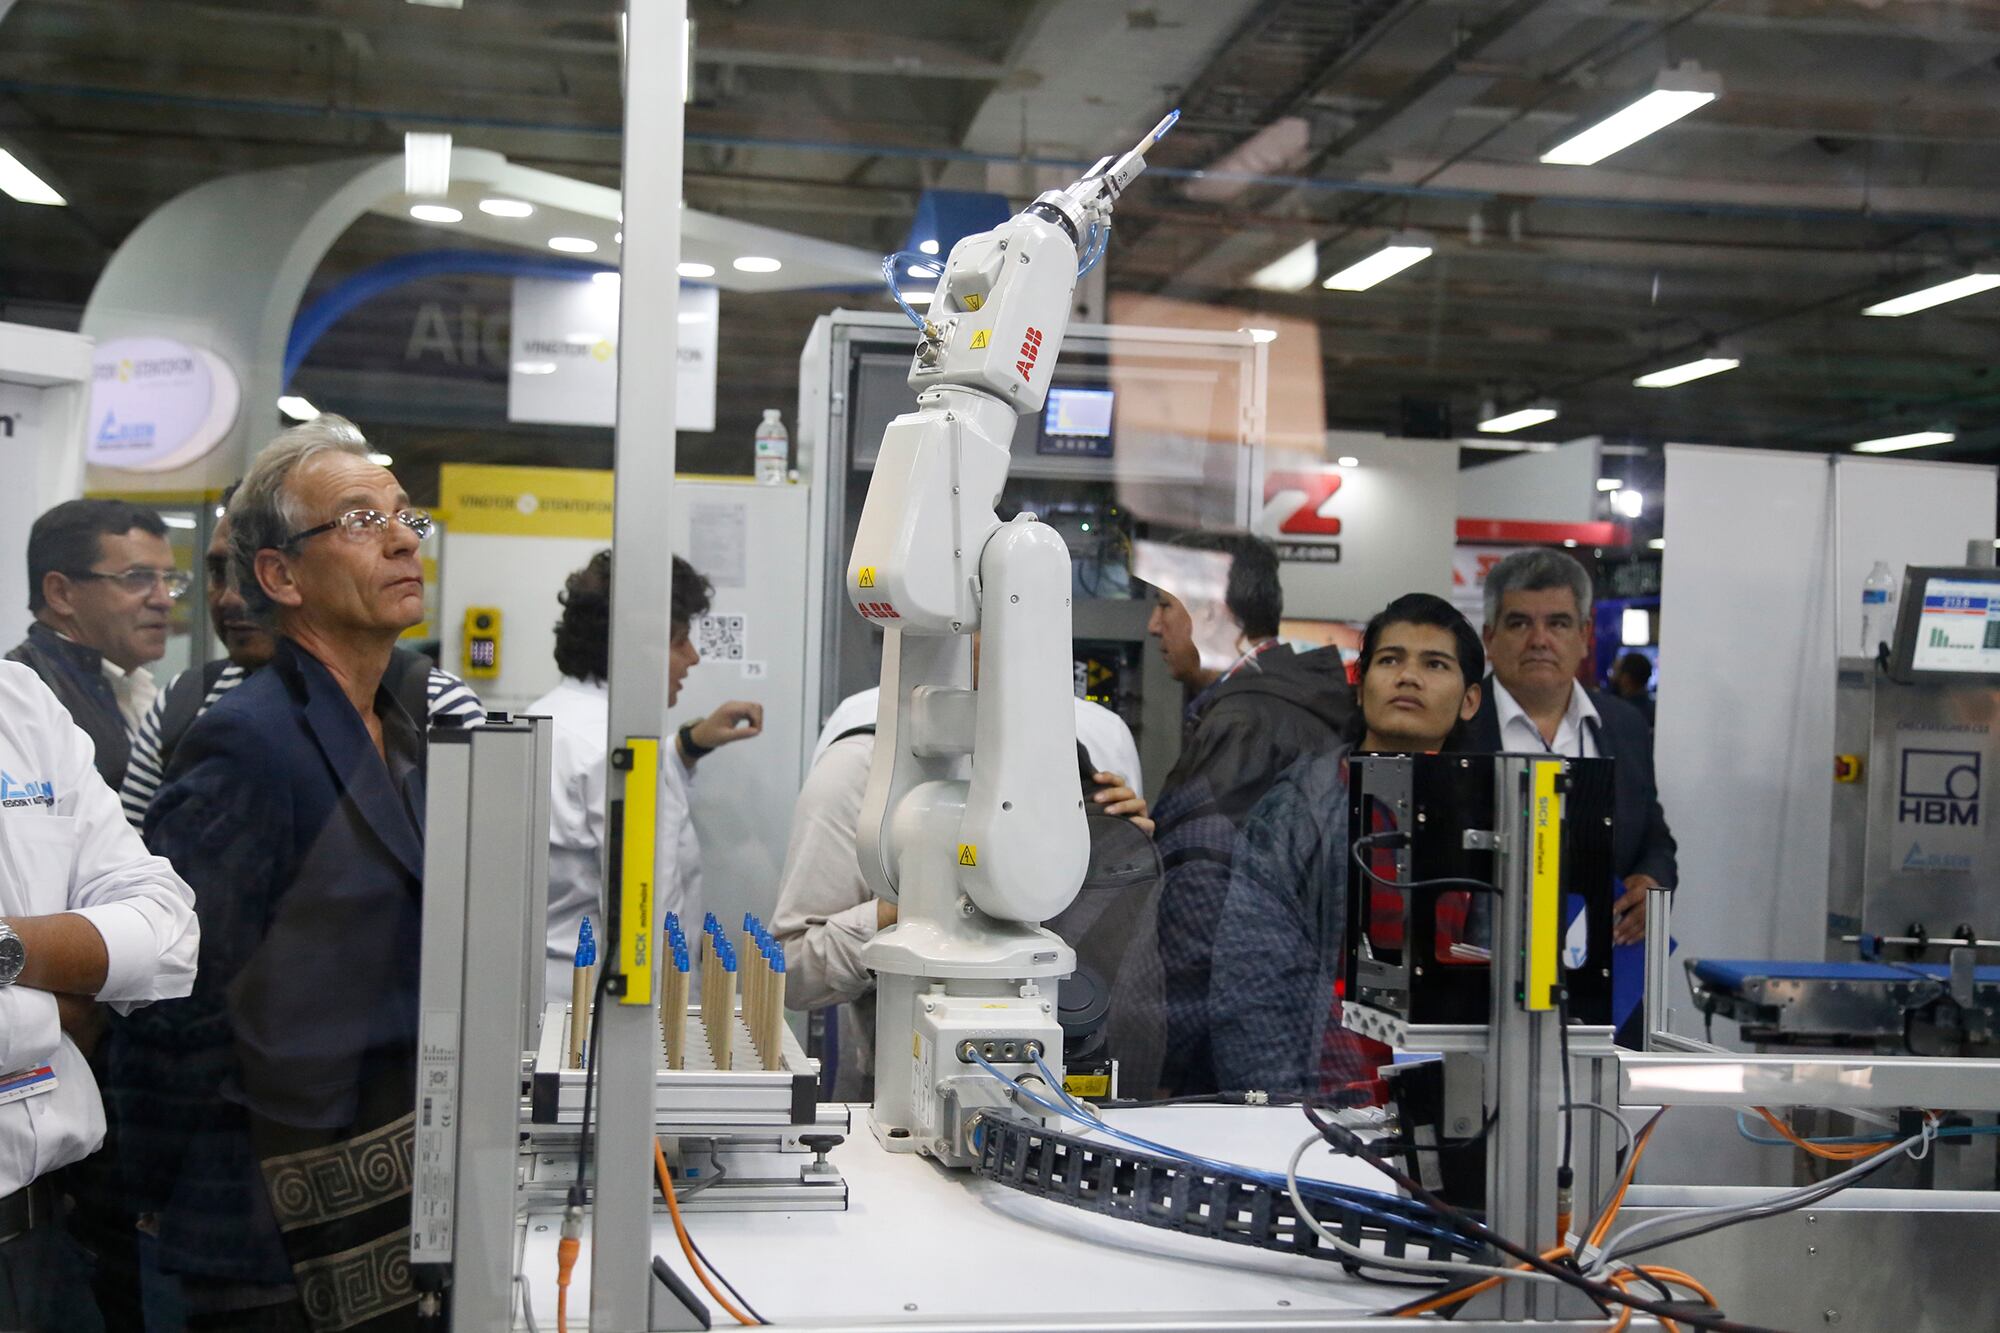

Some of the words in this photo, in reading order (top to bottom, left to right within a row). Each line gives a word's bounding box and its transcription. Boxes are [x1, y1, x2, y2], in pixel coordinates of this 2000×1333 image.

[1016, 327, 1043, 382] ABB
[858, 602, 901, 618] ABB
[1540, 796, 1549, 827] SICK
[1899, 800, 1979, 826] HBM
[635, 933, 646, 967] SICK
